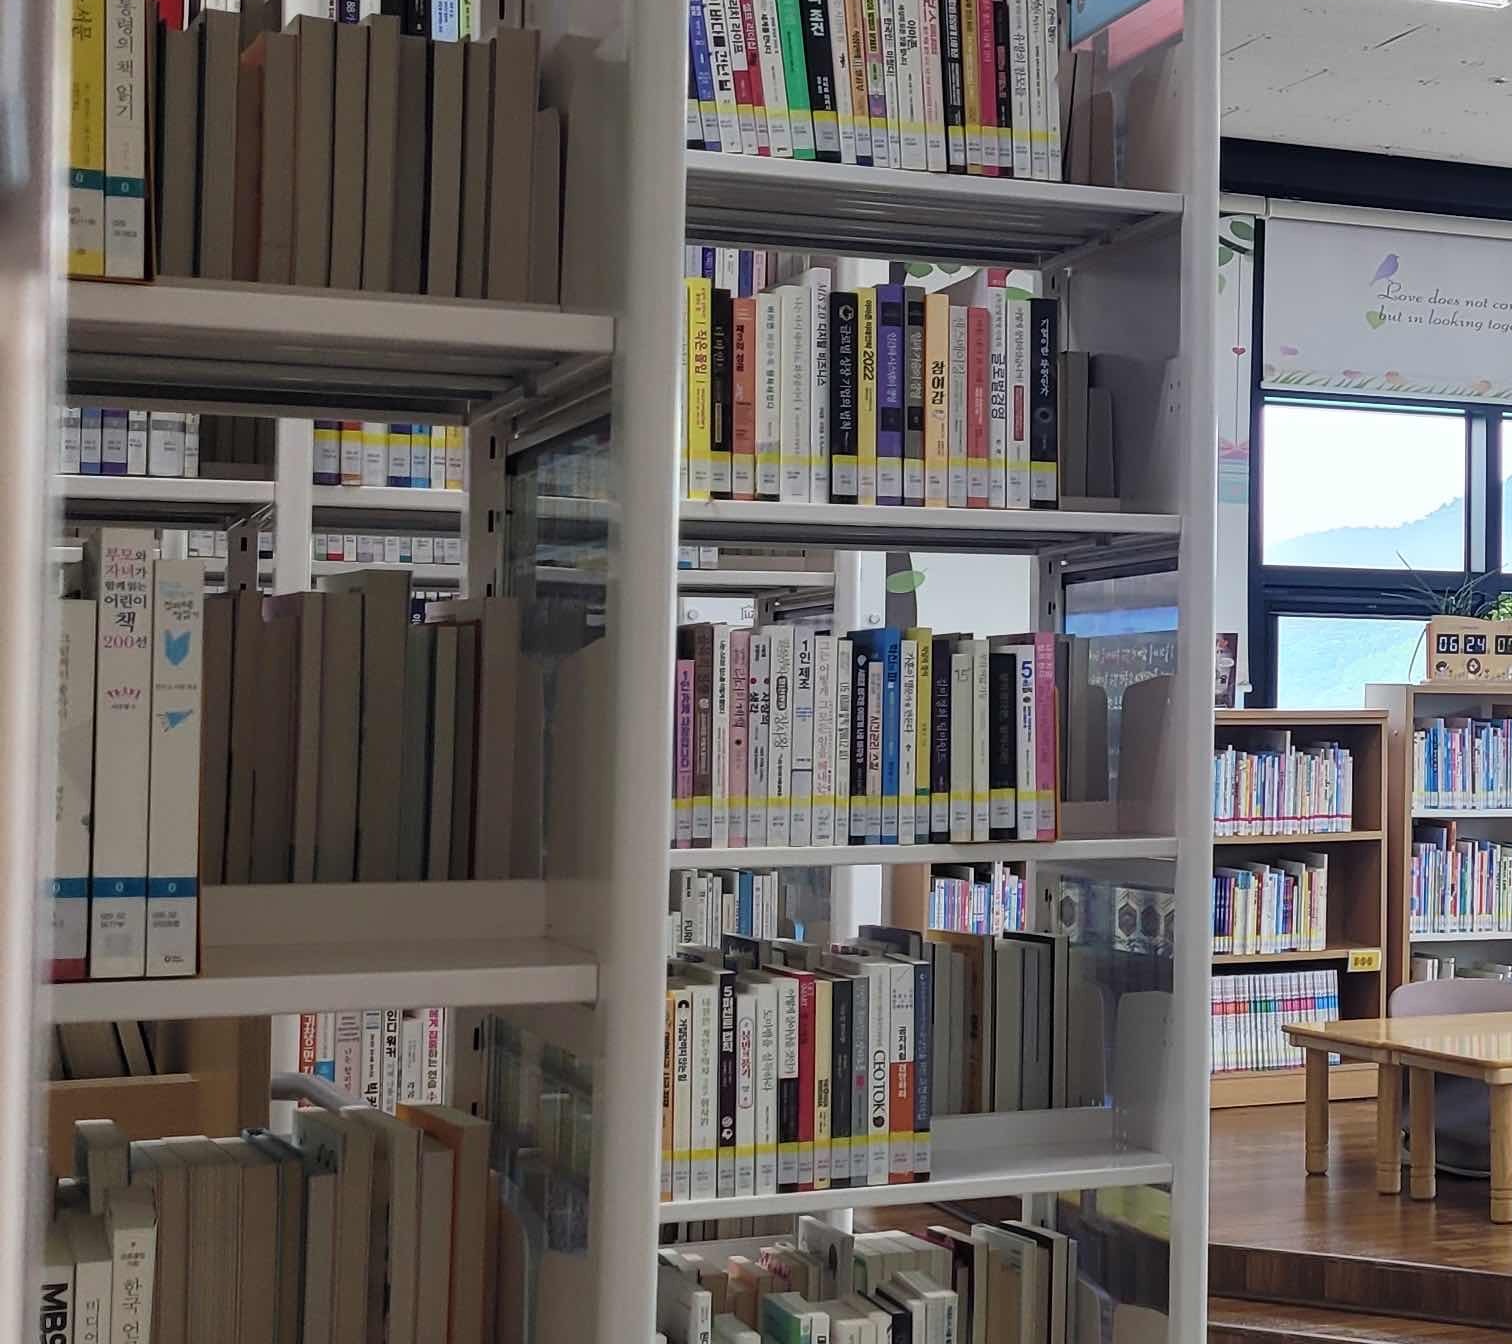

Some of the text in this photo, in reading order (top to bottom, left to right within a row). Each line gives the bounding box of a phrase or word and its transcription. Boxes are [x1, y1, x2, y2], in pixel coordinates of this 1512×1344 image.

[73, 5, 95, 41] 서문
[729, 22, 744, 55] 라이프
[117, 59, 134, 78] 책
[1377, 279, 1423, 305] Love
[1428, 288, 1461, 307] does
[1465, 298, 1489, 313] not
[1379, 304, 1403, 324] but
[1408, 313, 1424, 325] in
[1428, 308, 1485, 332] looking
[816, 322, 828, 386] 디지털 비즈니스
[839, 325, 852, 354] 글로벌
[694, 353, 708, 375] 몰입
[862, 350, 874, 381] 2022
[931, 360, 946, 406] 참여감
[105, 547, 147, 561] 부모와
[104, 594, 147, 609] 어린이
[115, 611, 137, 632] 책
[103, 635, 148, 650] 200선
[1438, 636, 1486, 652] 06 24
[798, 639, 811, 691] 1인 제조
[749, 691, 759, 714] 생각
[760, 692, 770, 725] 사장의
[872, 1050, 886, 1113] CEO TOK
[122, 1278, 143, 1315] 한국
